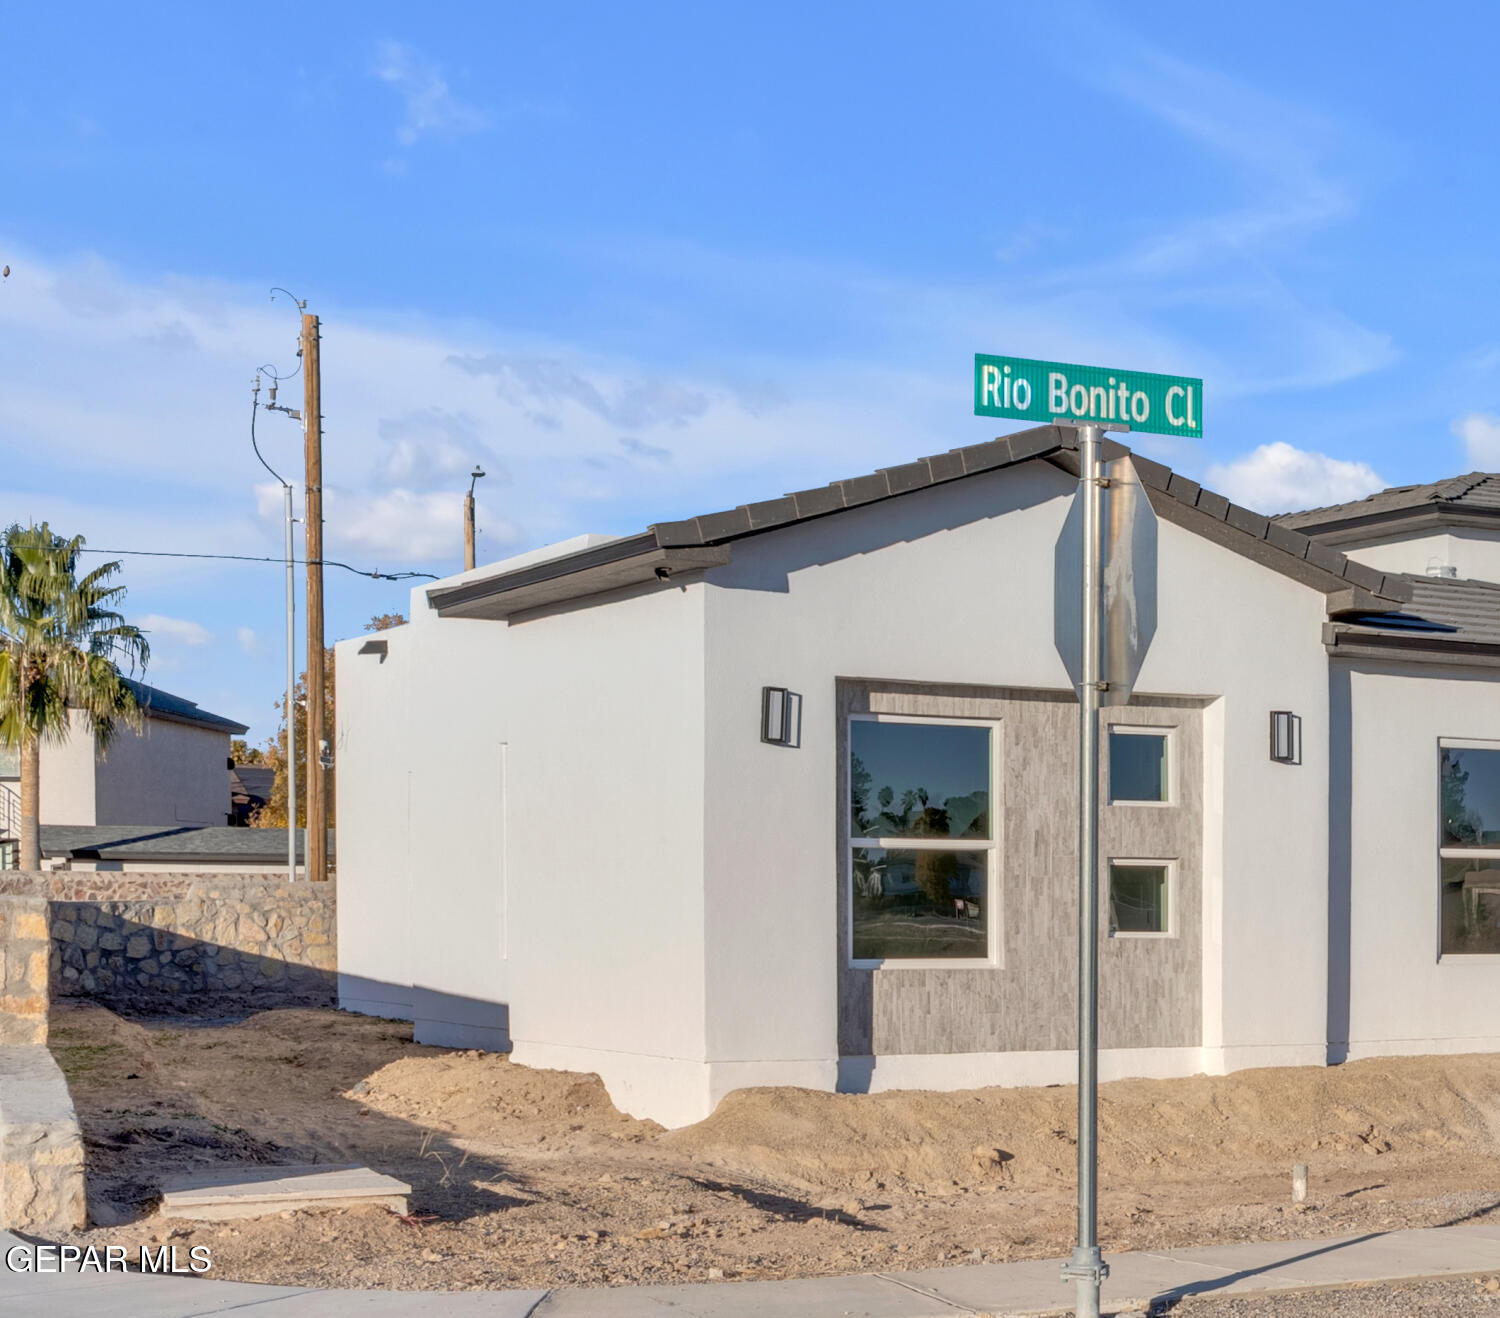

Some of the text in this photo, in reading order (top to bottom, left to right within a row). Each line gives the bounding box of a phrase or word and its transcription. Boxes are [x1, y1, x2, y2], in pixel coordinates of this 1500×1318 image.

[981, 364, 1197, 428] Rio Bonito Cl
